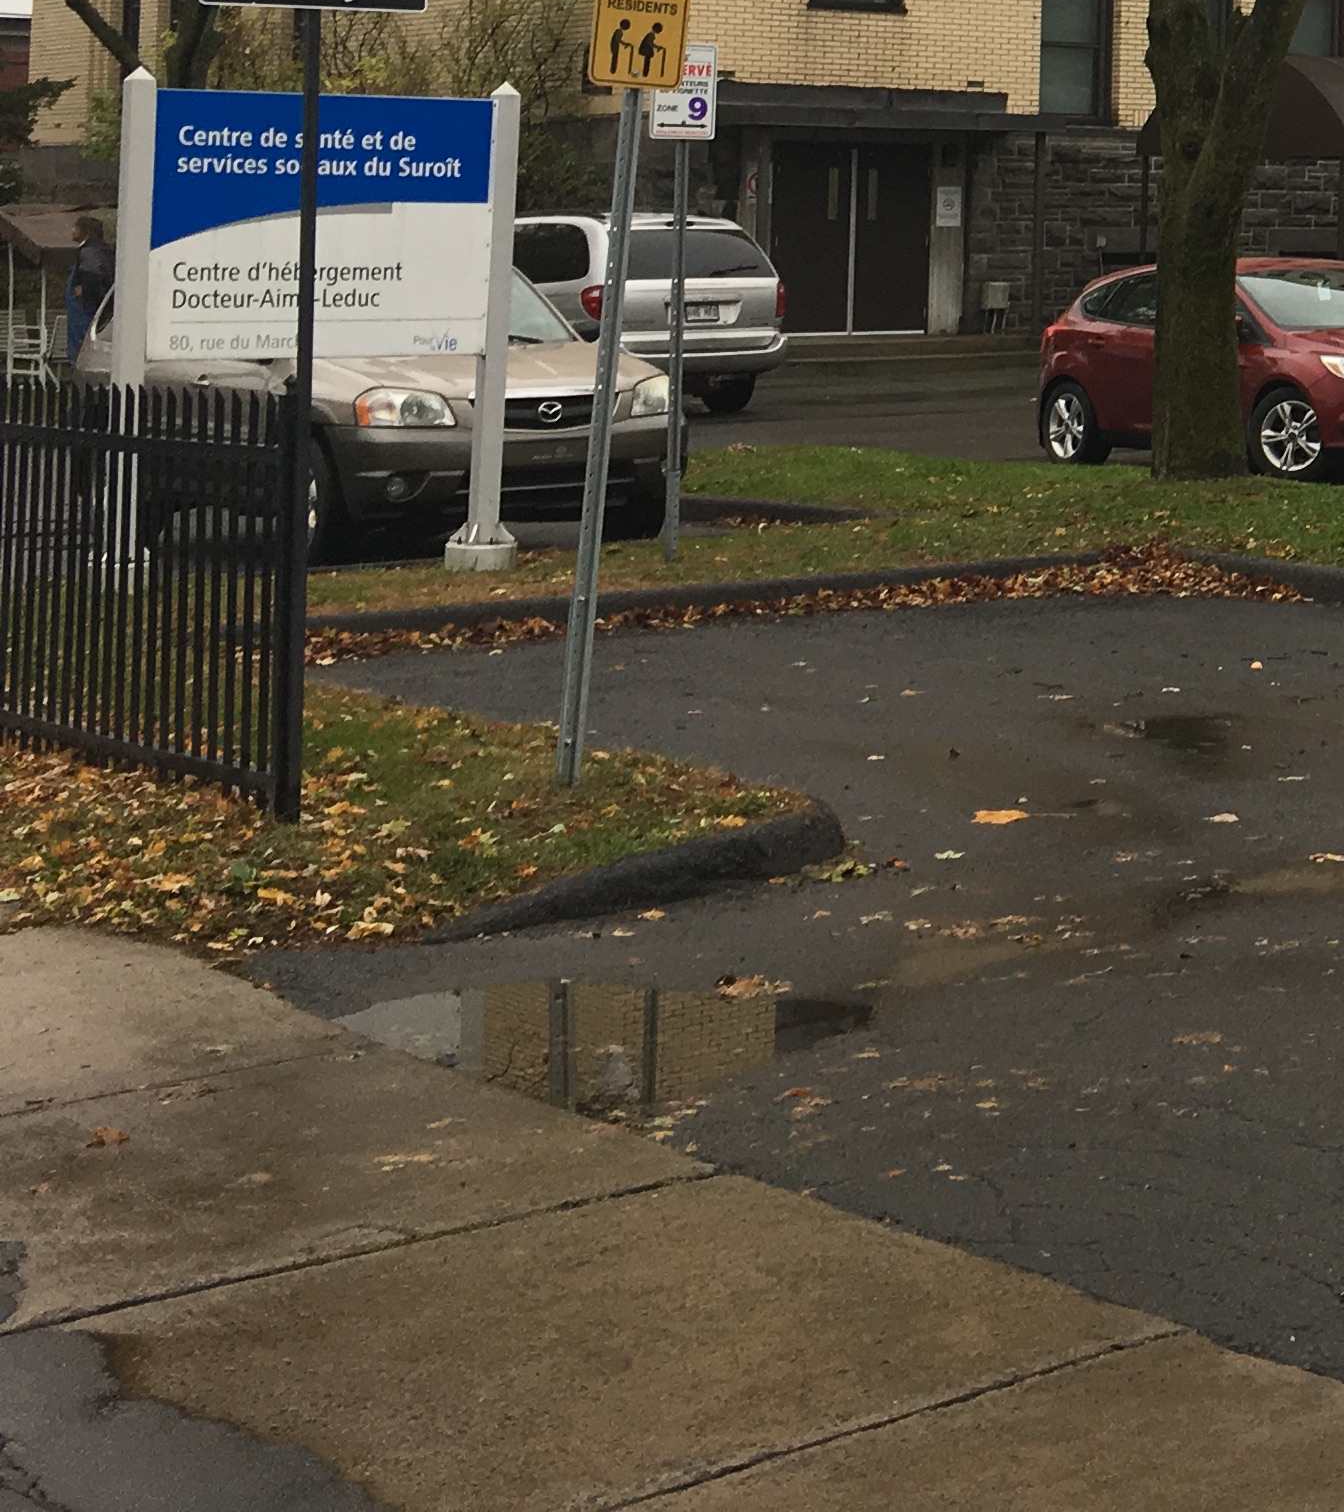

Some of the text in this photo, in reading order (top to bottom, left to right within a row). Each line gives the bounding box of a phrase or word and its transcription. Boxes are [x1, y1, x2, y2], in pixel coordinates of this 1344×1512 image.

[683, 62, 712, 77] ERVÉ
[688, 96, 708, 121] 9
[178, 125, 416, 151] Centre de snté et de
[177, 153, 462, 178] services soaux du Suroît
[173, 261, 241, 282] Centre
[172, 288, 380, 309] Docteur-Aim-Leduc
[169, 334, 299, 352] 80, rue du Marc
[432, 328, 458, 351] Vie
